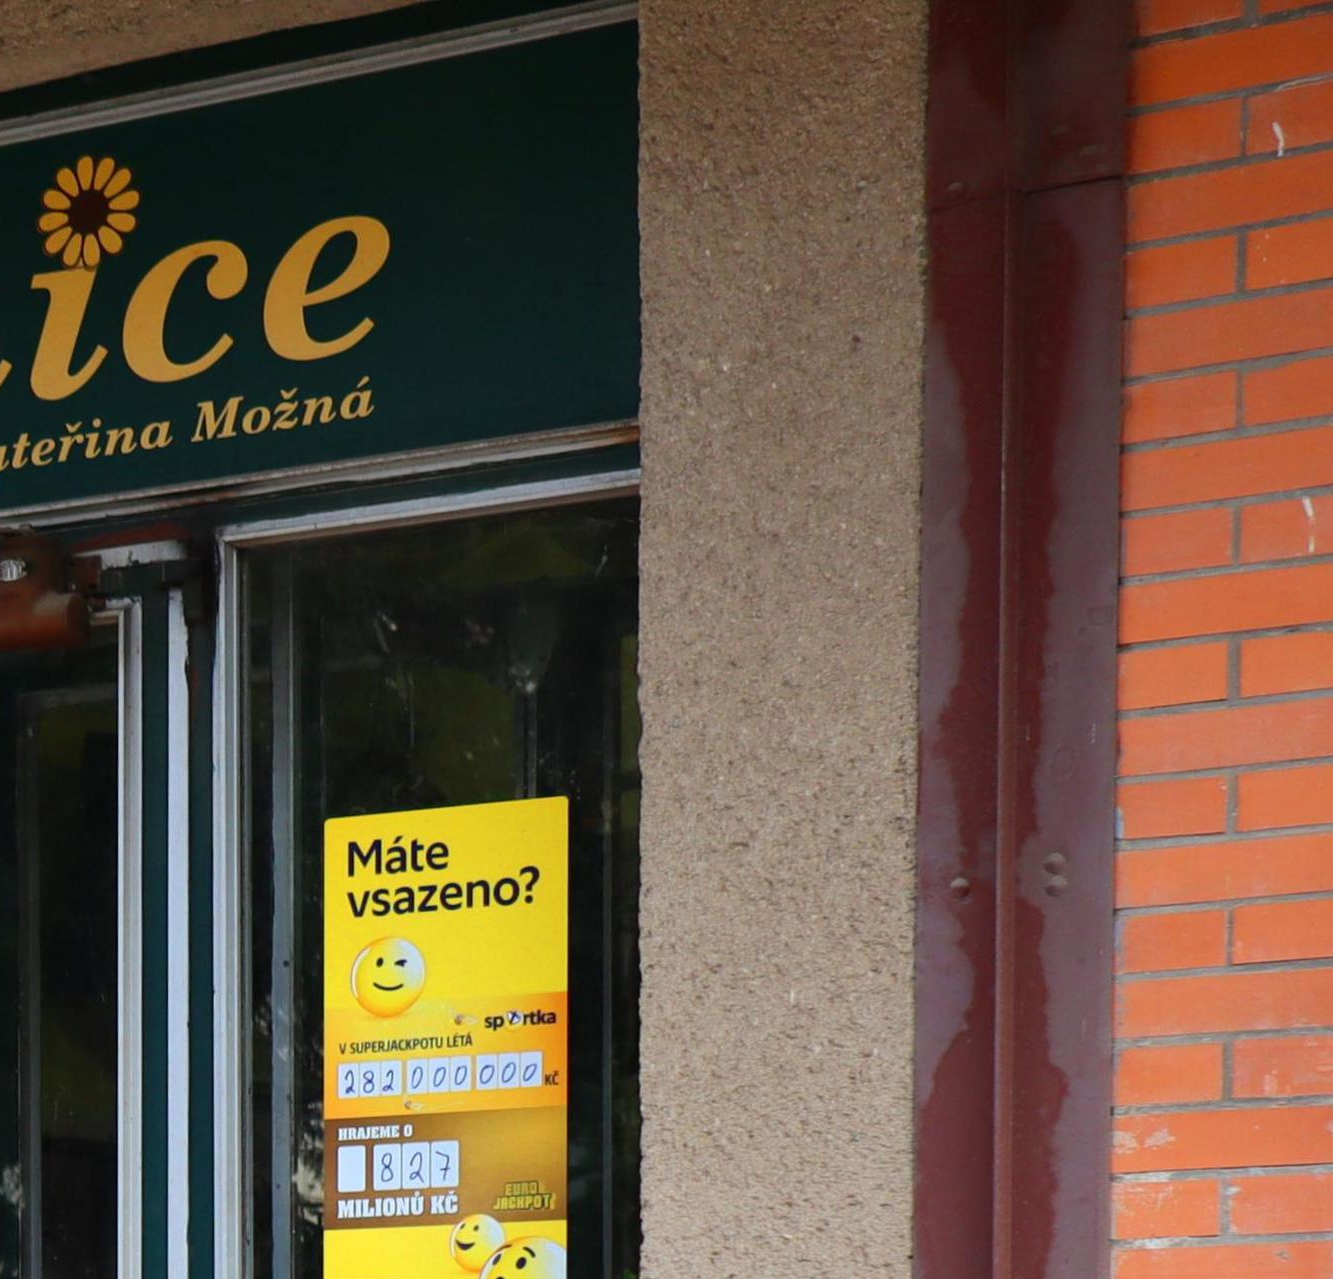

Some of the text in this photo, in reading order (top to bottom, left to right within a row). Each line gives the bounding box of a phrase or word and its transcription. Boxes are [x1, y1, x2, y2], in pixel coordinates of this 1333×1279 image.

[194, 377, 375, 444] Možná
[346, 835, 450, 877] Máte
[346, 866, 541, 918] vsazeno?
[338, 1033, 473, 1056] V SUPERJACKPOTU LÉTÁ
[337, 1124, 414, 1142] HRAJEME O
[337, 1190, 459, 1219] MILIONŮ KČ
[492, 1194, 551, 1210] JACKPOT
